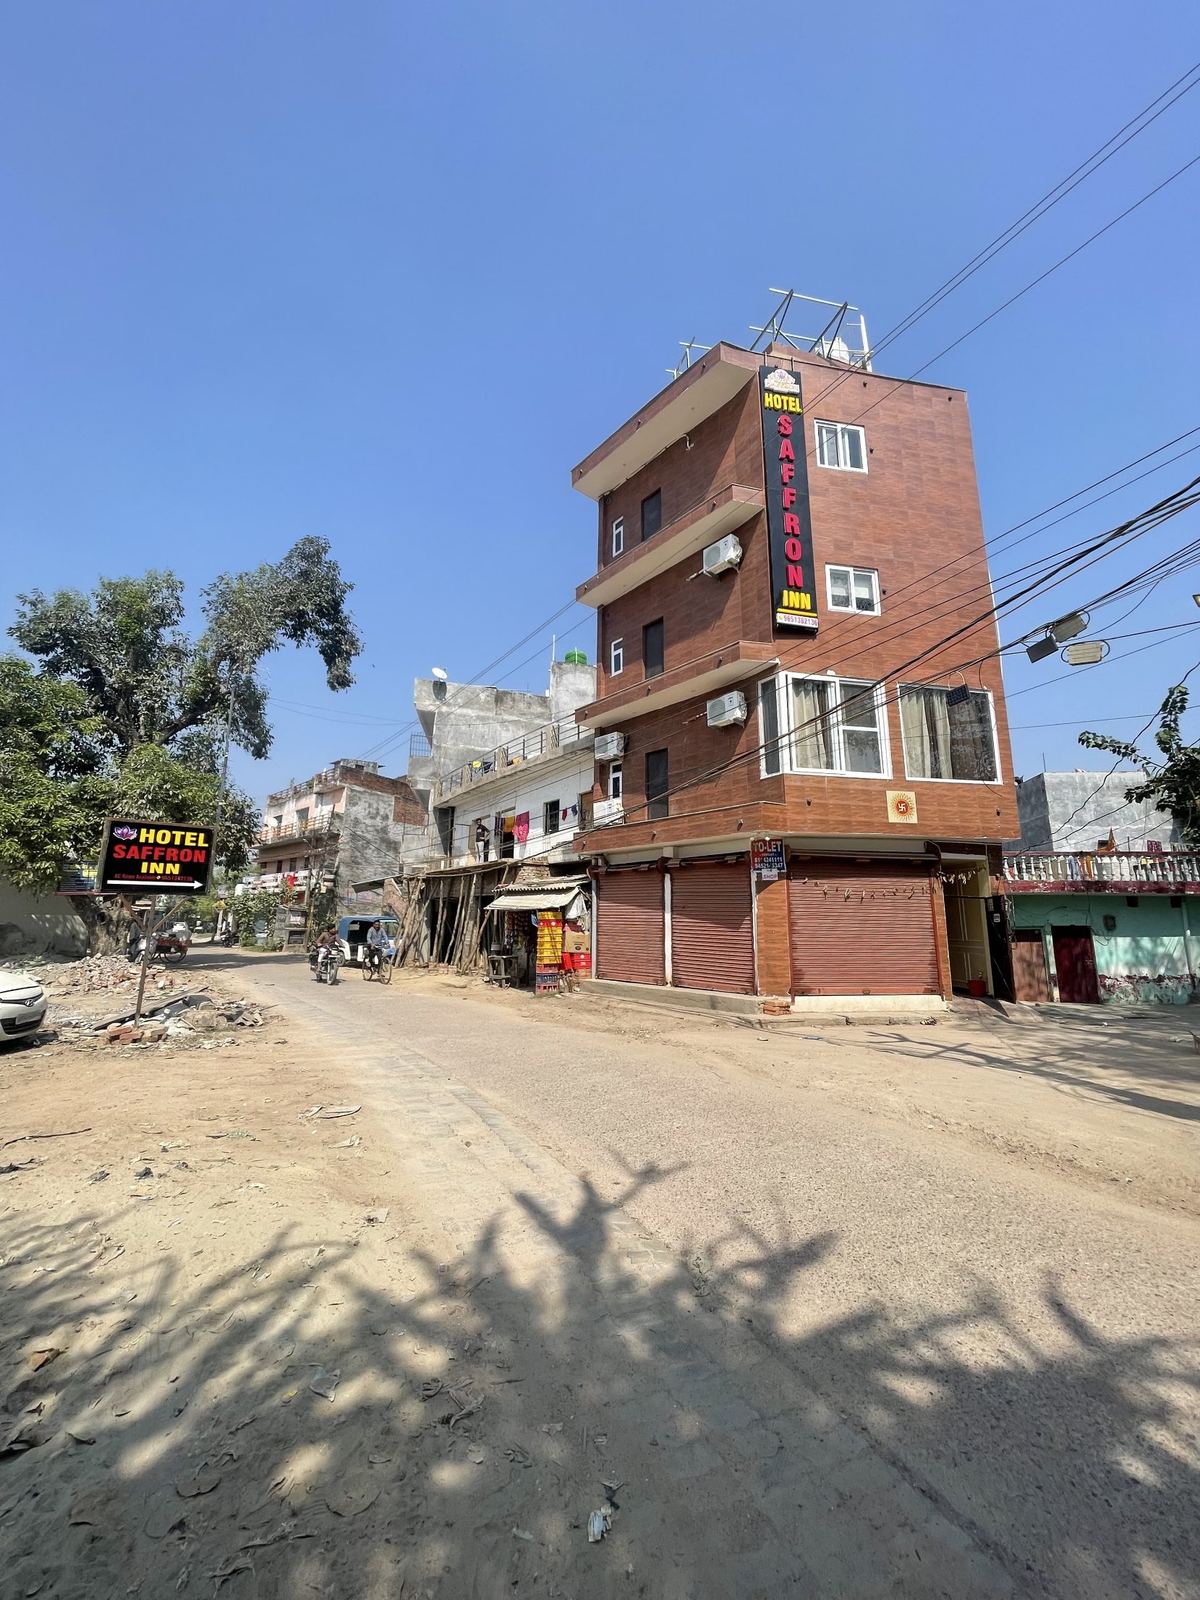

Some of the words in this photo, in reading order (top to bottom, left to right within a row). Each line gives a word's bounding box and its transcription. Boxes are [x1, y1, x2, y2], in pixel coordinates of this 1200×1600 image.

[764, 393, 802, 413] HOTEL
[778, 415, 803, 588] SAFFRON
[782, 589, 811, 610] INN
[139, 828, 208, 847] HOTEL
[113, 844, 206, 863] SAFFRON
[140, 862, 180, 875] INN
